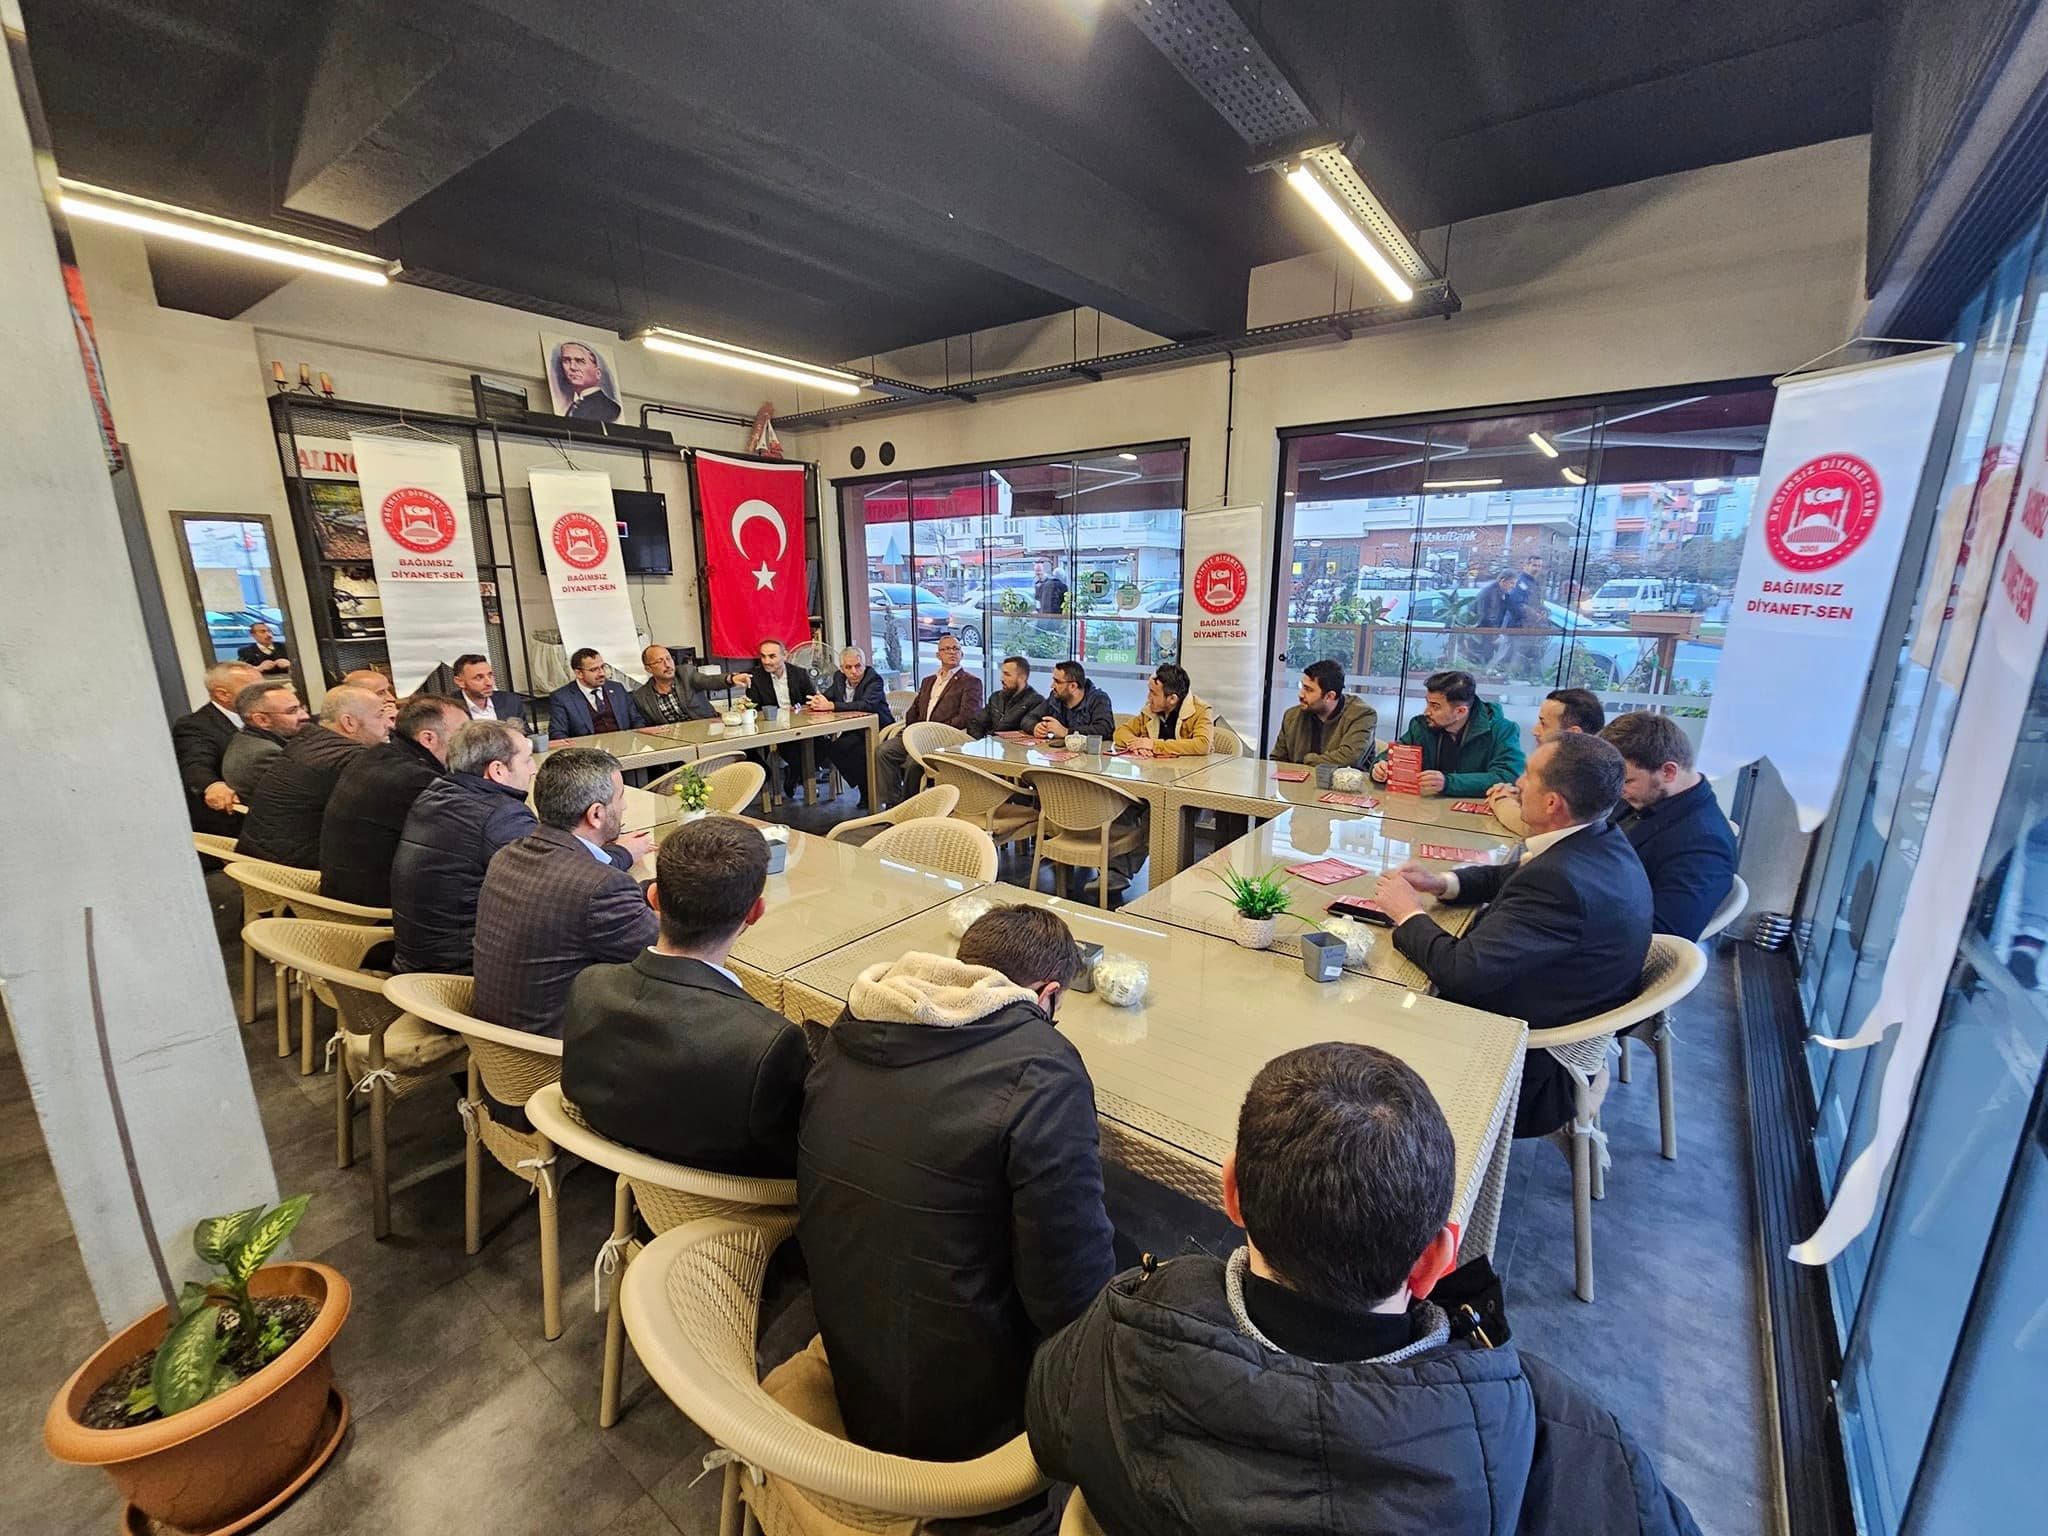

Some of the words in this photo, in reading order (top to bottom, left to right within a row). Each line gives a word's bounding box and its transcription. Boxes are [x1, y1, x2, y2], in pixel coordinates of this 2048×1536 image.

[1770, 464, 1816, 521] BAĞIMSIZ
[1820, 458, 1876, 518] DİYANET-SEN
[399, 557, 453, 567] BAĞIMSIZ
[391, 570, 464, 579] DİYANET-SEN
[567, 573, 608, 581] BAĞIMSIZ
[562, 584, 617, 593] DİYANET-SEN
[1762, 579, 1844, 596] BAĞIMSIZ
[1746, 599, 1853, 620] DİYANET-SEN
[1200, 618, 1240, 627] BAĞIMSIZ
[1193, 630, 1247, 638] DİYANET-SEN
